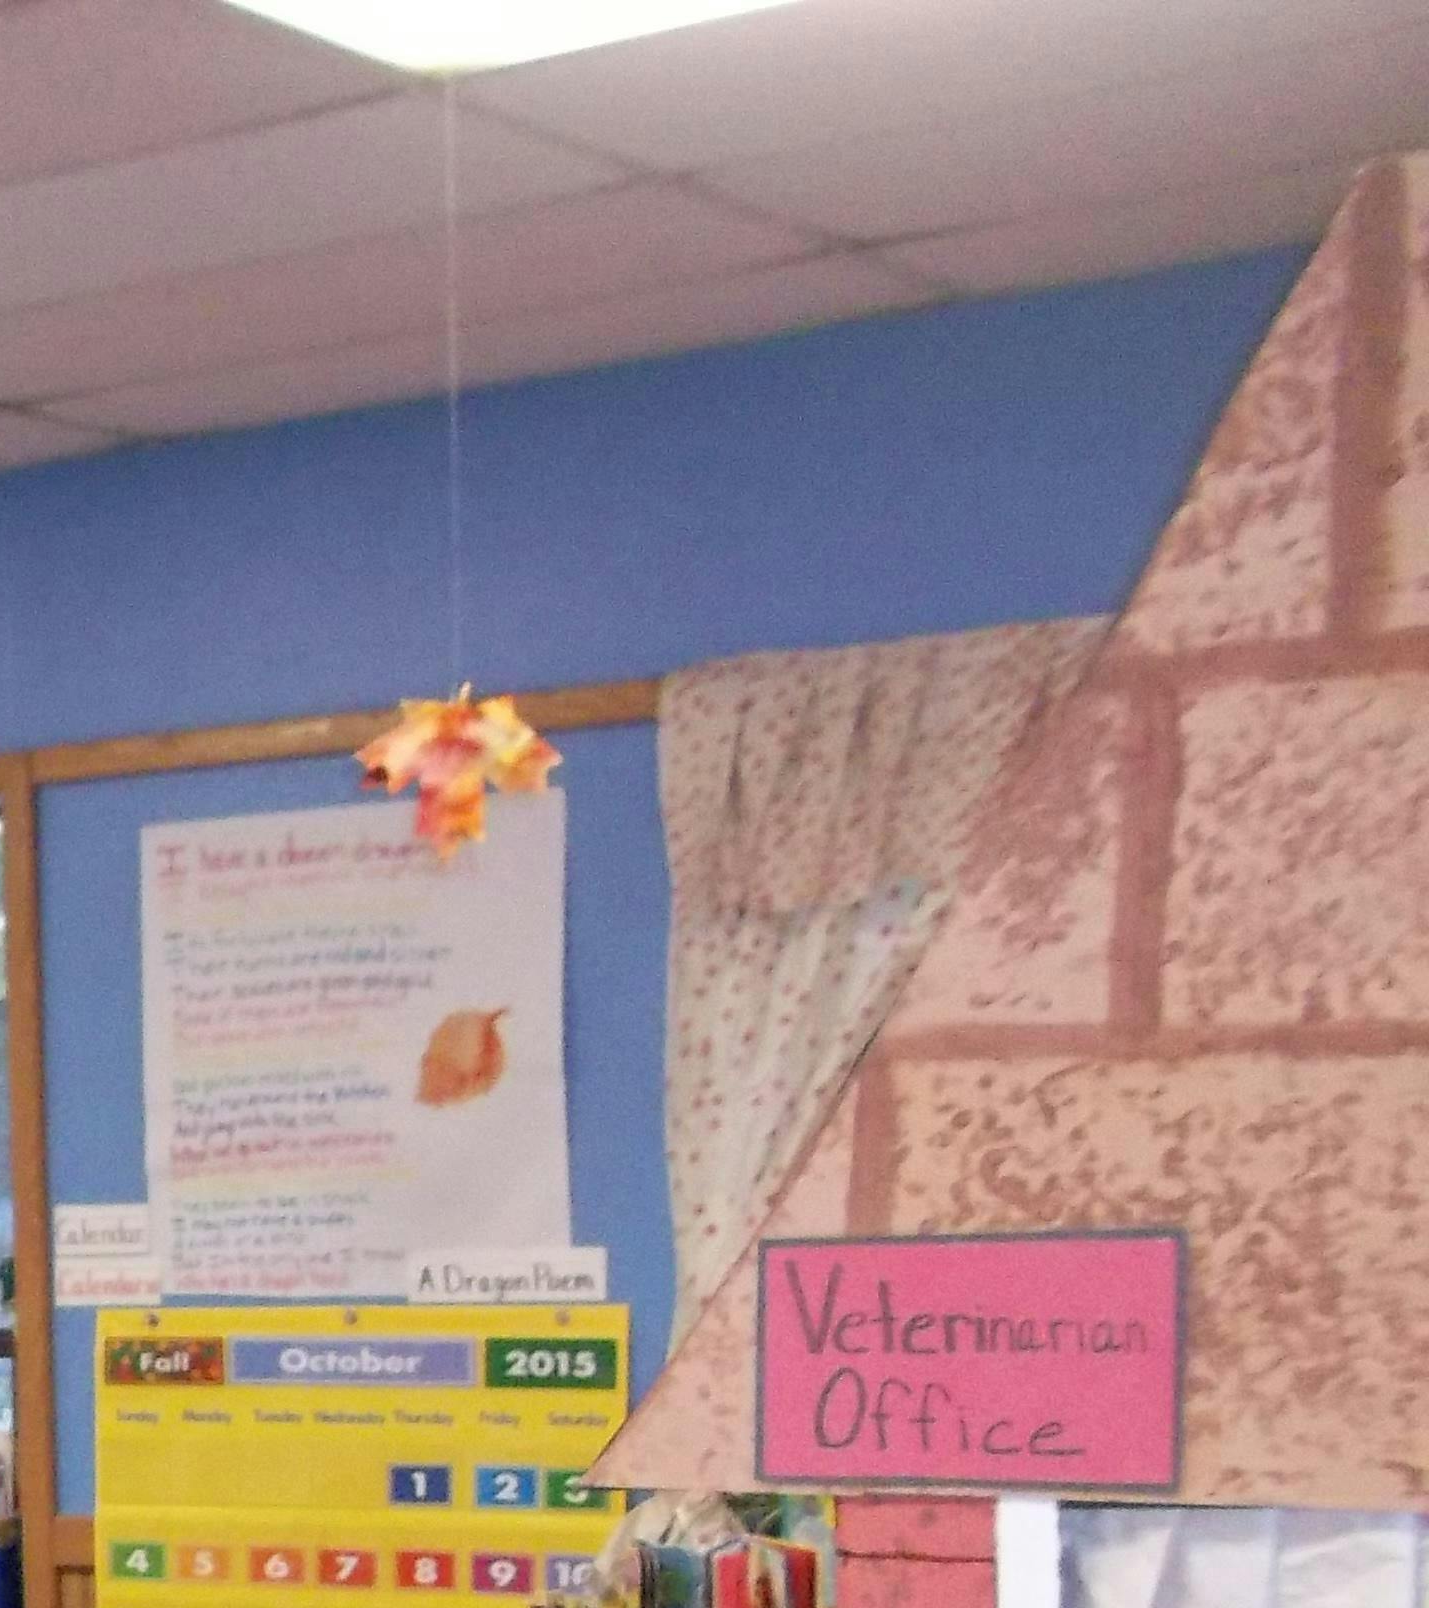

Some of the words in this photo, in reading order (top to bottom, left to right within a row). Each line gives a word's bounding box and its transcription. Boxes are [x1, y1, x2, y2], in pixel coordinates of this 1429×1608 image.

[419, 1265, 435, 1291] A
[444, 1265, 527, 1300] Dragon
[532, 1263, 596, 1292] Poem
[139, 1349, 190, 1373] Fall
[279, 1346, 423, 1376] October
[504, 1349, 598, 1378] 2015
[813, 1367, 1086, 1457] Office
[411, 1471, 427, 1498] 1
[494, 1471, 519, 1500] 2
[125, 1549, 150, 1574] 4
[192, 1551, 215, 1575] 5
[264, 1553, 290, 1579] 6
[334, 1554, 360, 1582] 7
[412, 1556, 439, 1584] 8
[487, 1559, 516, 1587] 9
